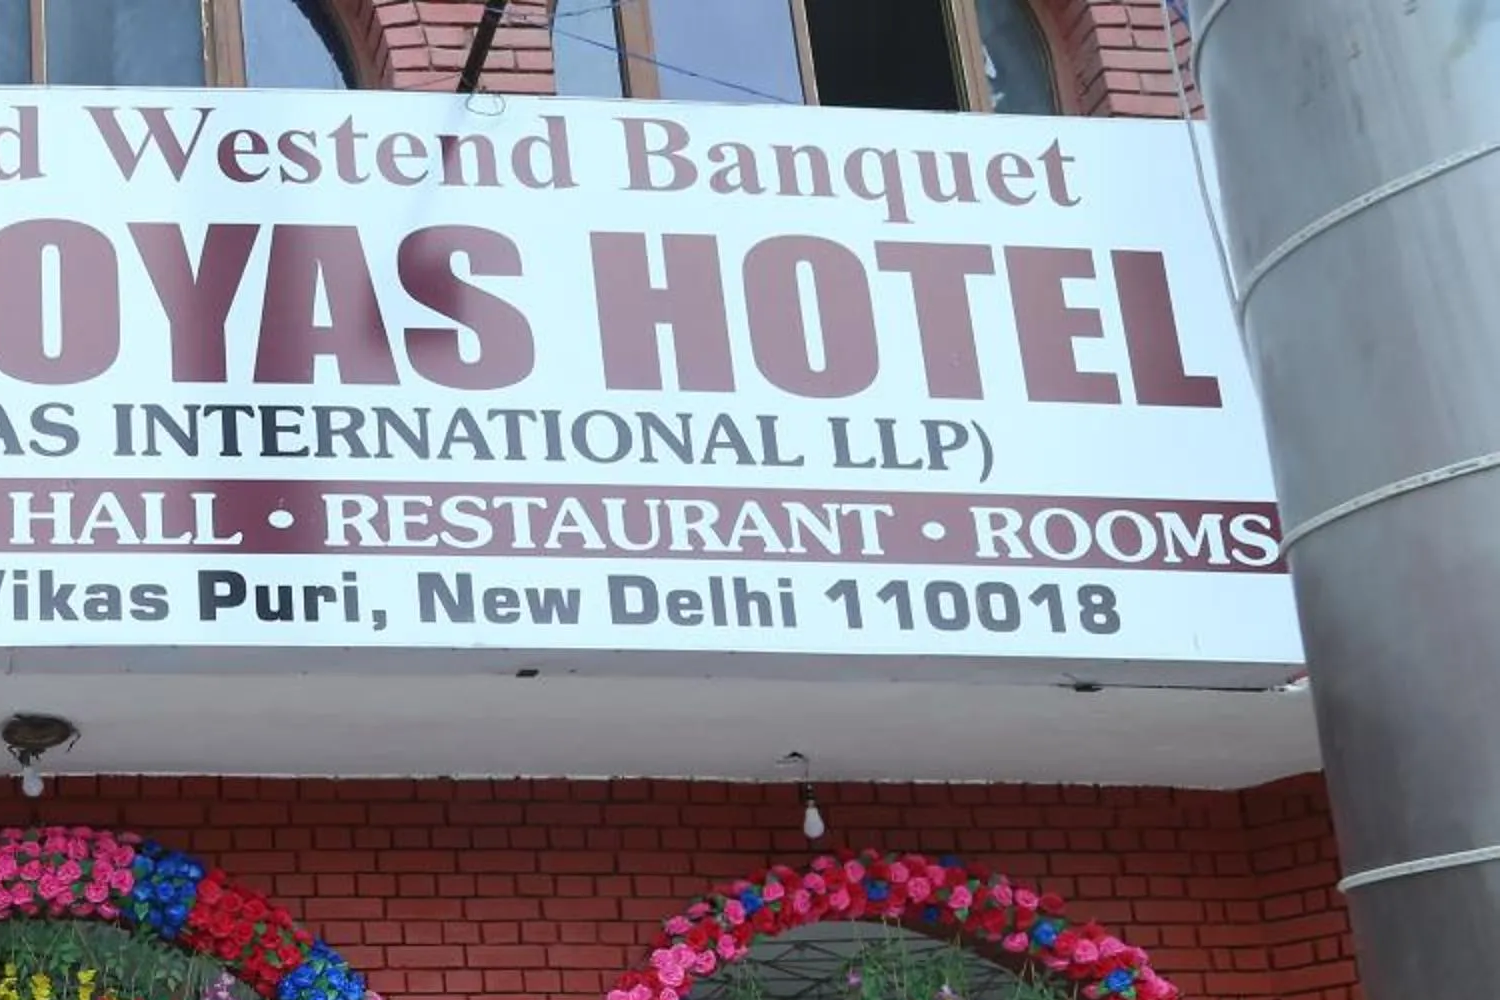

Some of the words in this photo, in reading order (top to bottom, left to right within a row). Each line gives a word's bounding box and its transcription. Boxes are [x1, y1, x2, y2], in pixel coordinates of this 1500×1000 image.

[83, 105, 581, 190] Westend
[612, 117, 1082, 224] Banquet
[589, 231, 1223, 409] HOTEL
[113, 403, 805, 467] INTERNATIONAL
[831, 418, 995, 484] LLP)
[8, 490, 243, 546] HALL
[322, 493, 894, 556] RESTAURANT
[968, 506, 1281, 567] ROOMS
[197, 569, 387, 632] Puri,
[416, 571, 581, 626] New
[607, 574, 798, 629] Delhi
[823, 578, 1121, 635] 110018
